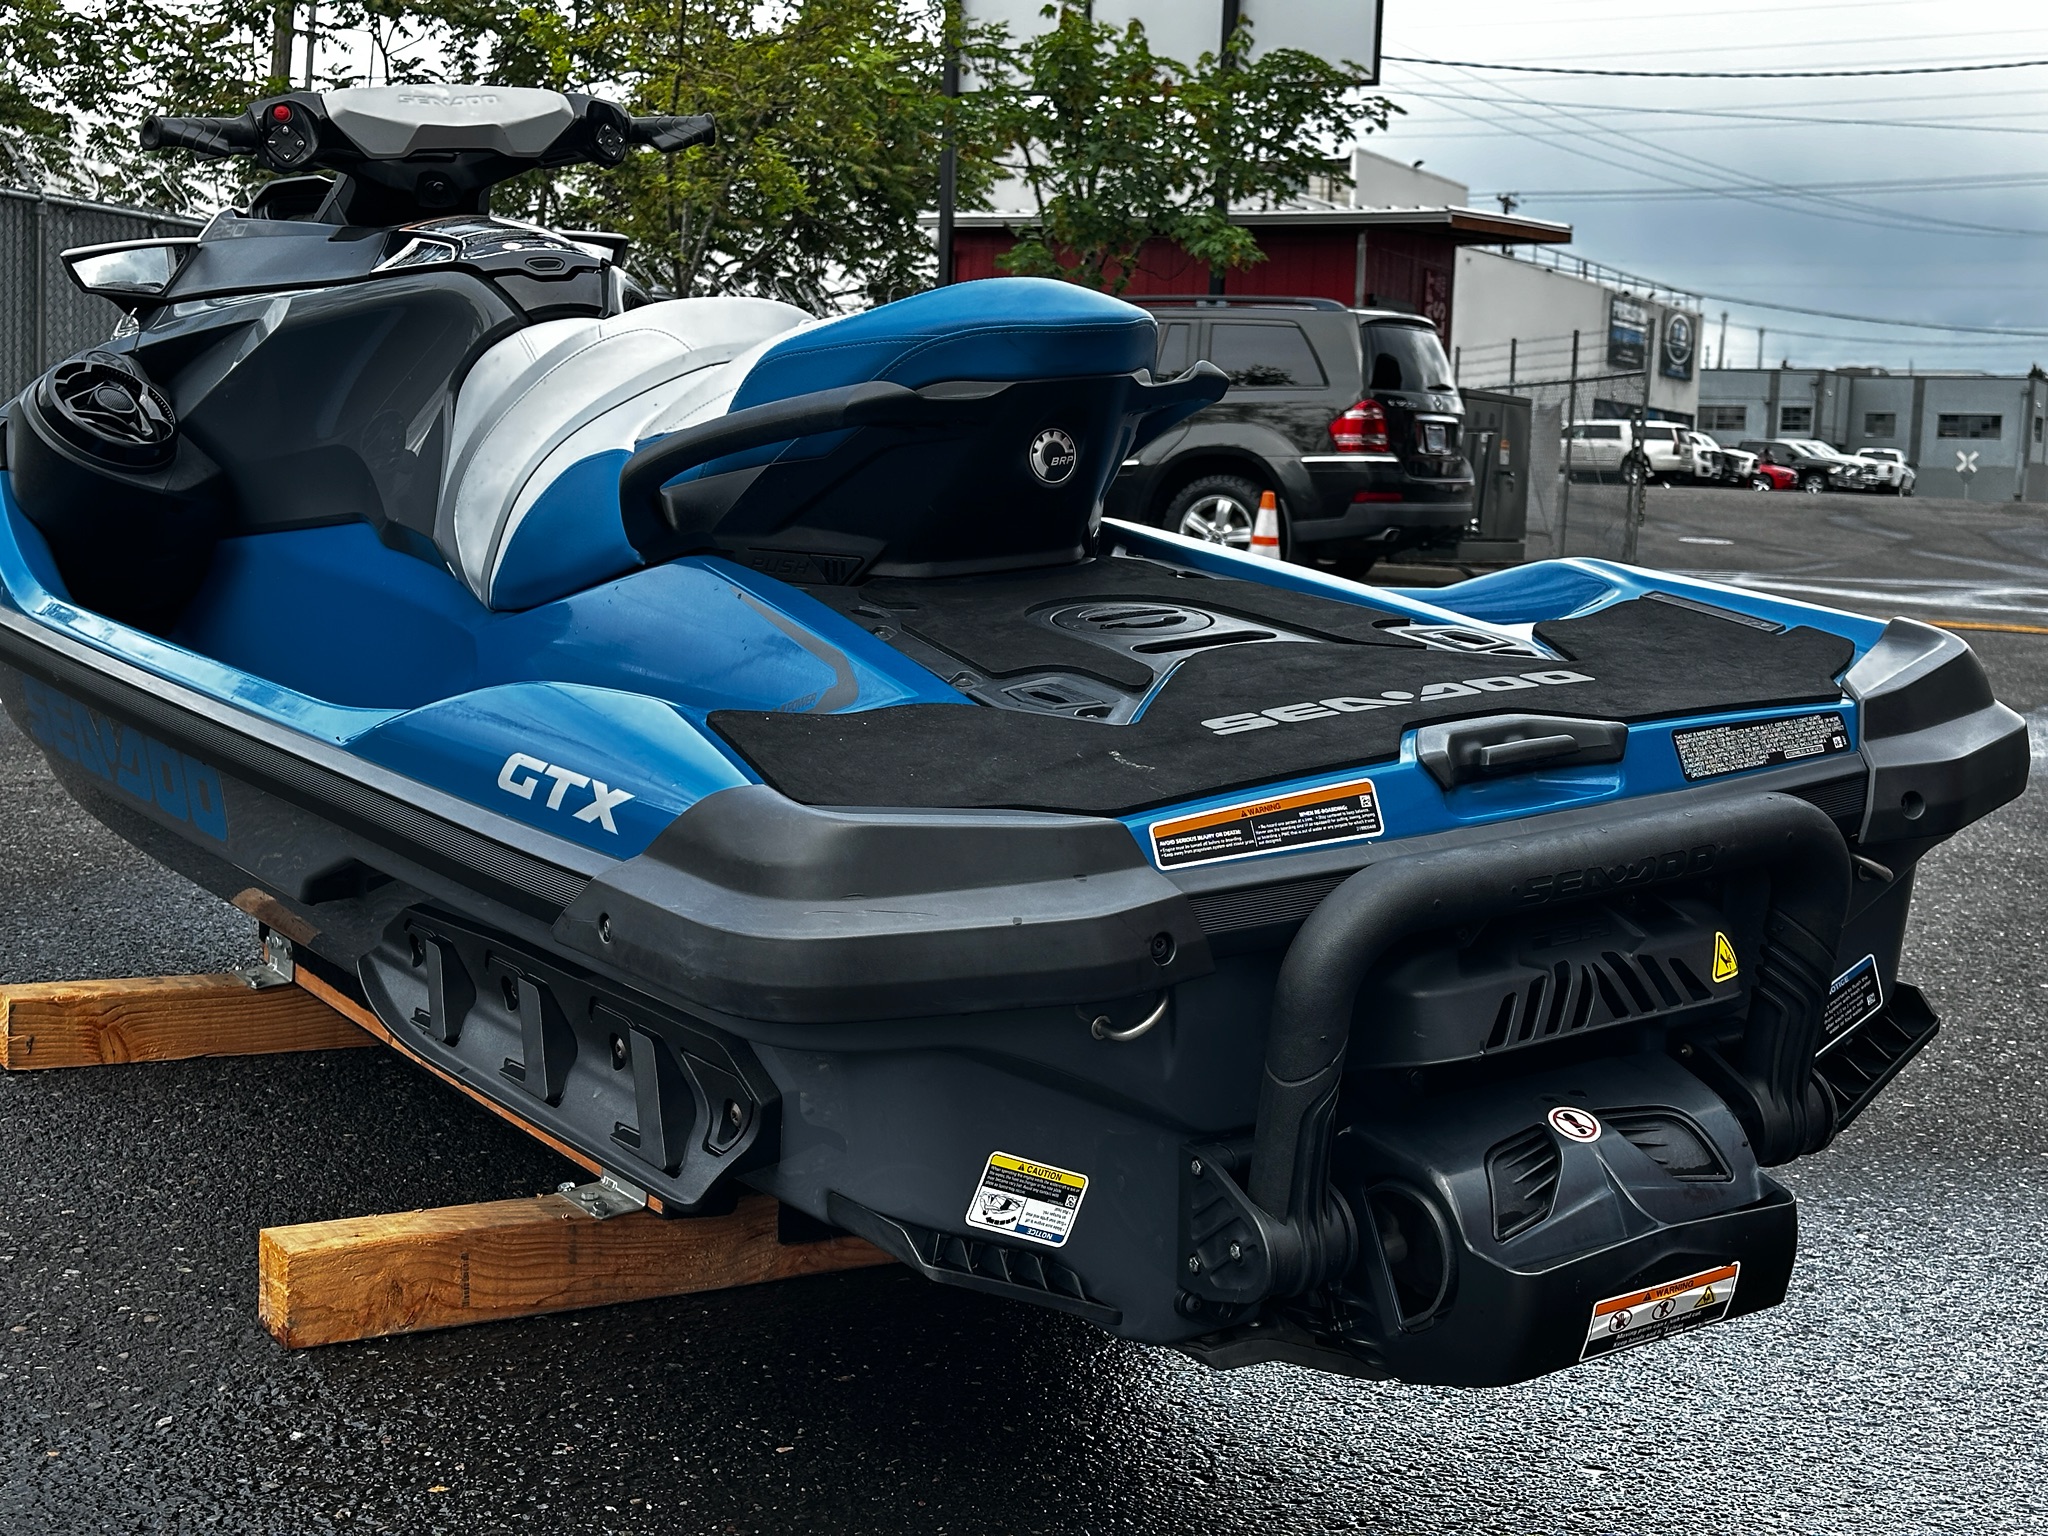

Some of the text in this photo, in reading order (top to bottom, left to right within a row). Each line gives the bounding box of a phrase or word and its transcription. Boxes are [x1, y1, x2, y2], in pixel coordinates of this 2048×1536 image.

[1051, 455, 1074, 466] BRP
[752, 557, 809, 575] PUSH
[497, 752, 637, 836] GTX
[1246, 803, 1282, 817] WARNING
[1829, 976, 1850, 995] OTICE
[1026, 1165, 1063, 1182] CAUTION
[1026, 1228, 1054, 1240] NOTICE
[1655, 1280, 1695, 1298] WARNING
